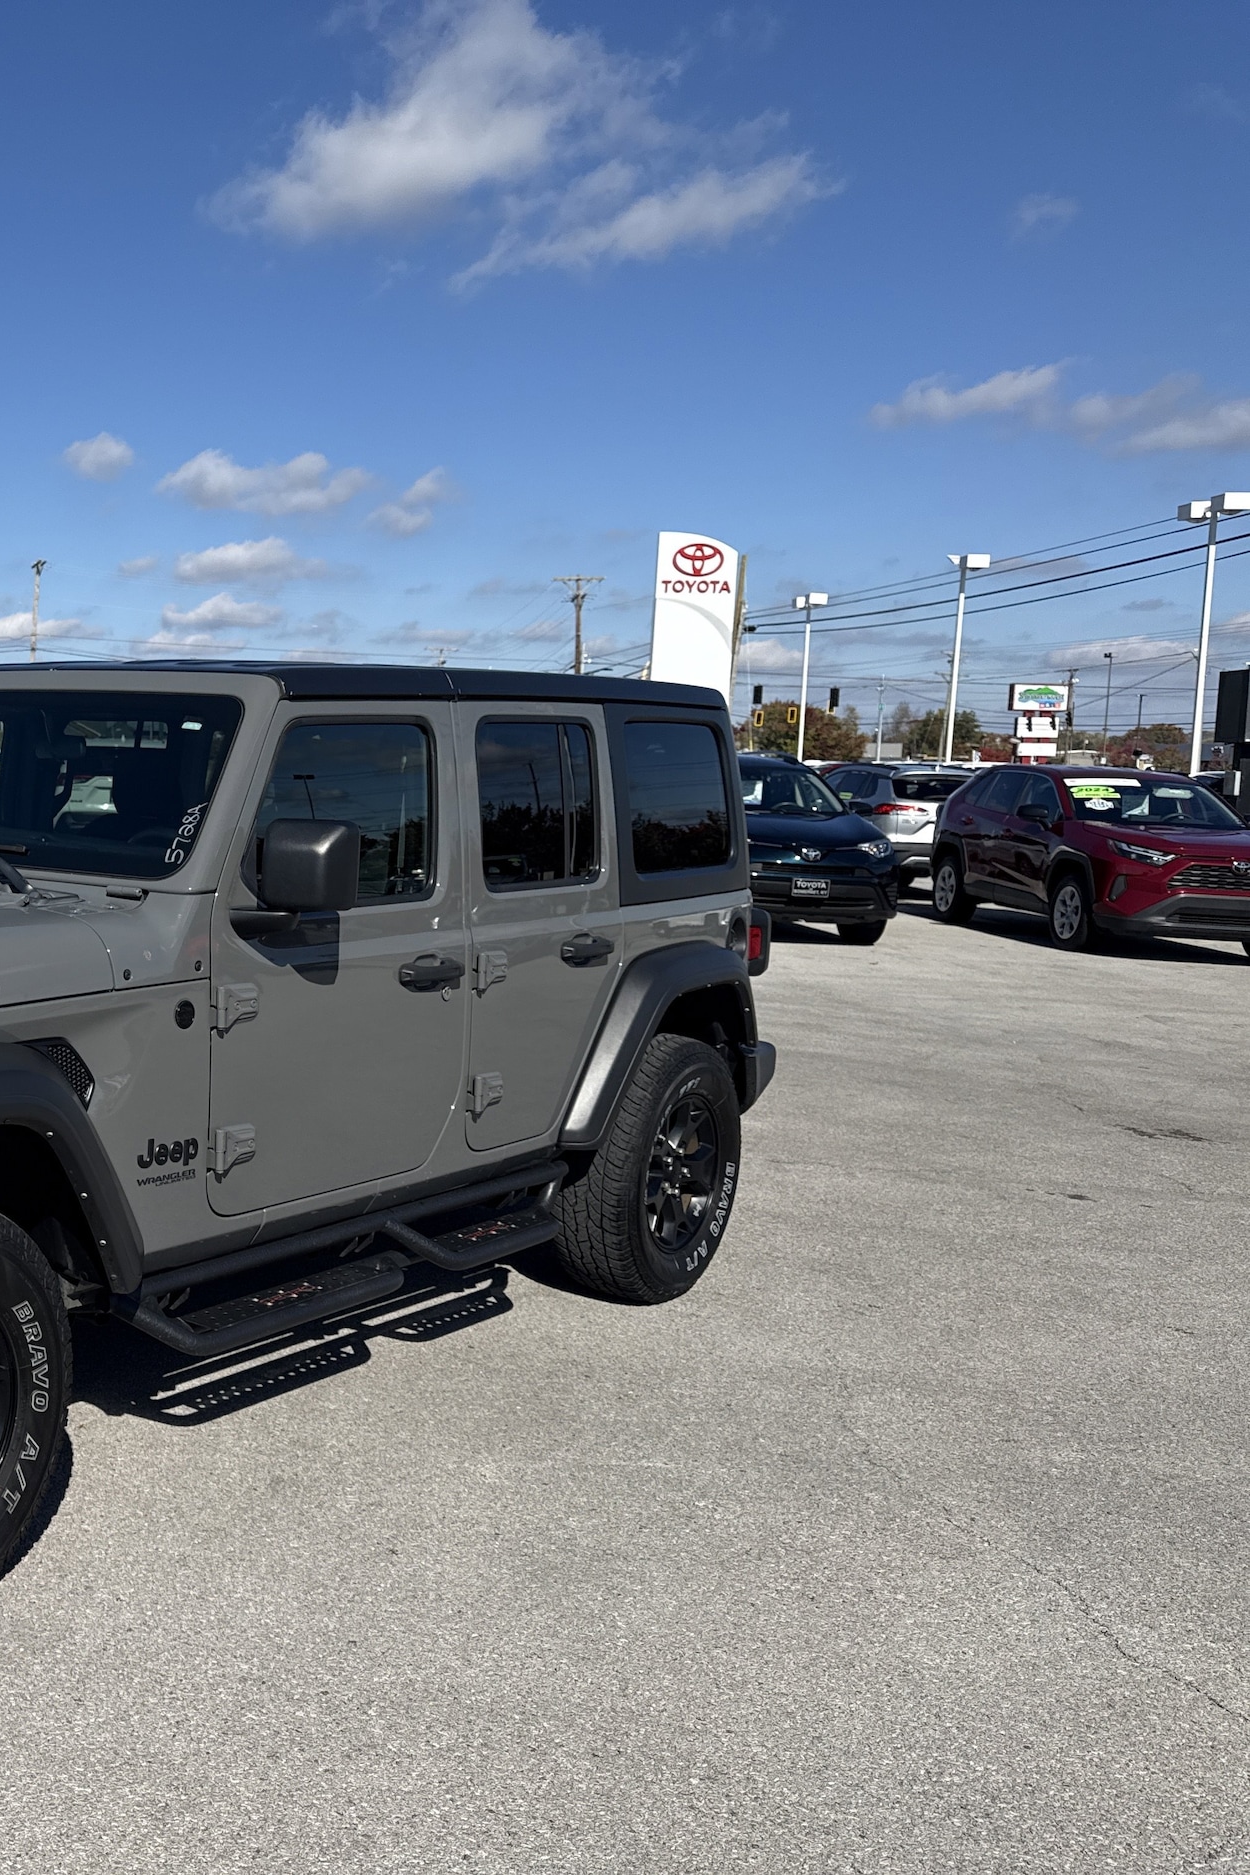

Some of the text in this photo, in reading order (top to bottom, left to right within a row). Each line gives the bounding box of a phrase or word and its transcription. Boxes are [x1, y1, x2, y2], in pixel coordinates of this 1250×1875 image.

[661, 580, 731, 594] TOYOTA
[164, 802, 208, 864] 5728A
[796, 880, 827, 889] TOYOTA
[137, 1137, 198, 1169] Jeep
[137, 1168, 196, 1187] WRANGLER
[685, 1161, 736, 1272] BRAVO A/T
[2, 1300, 49, 1514] BRAVO A/T
